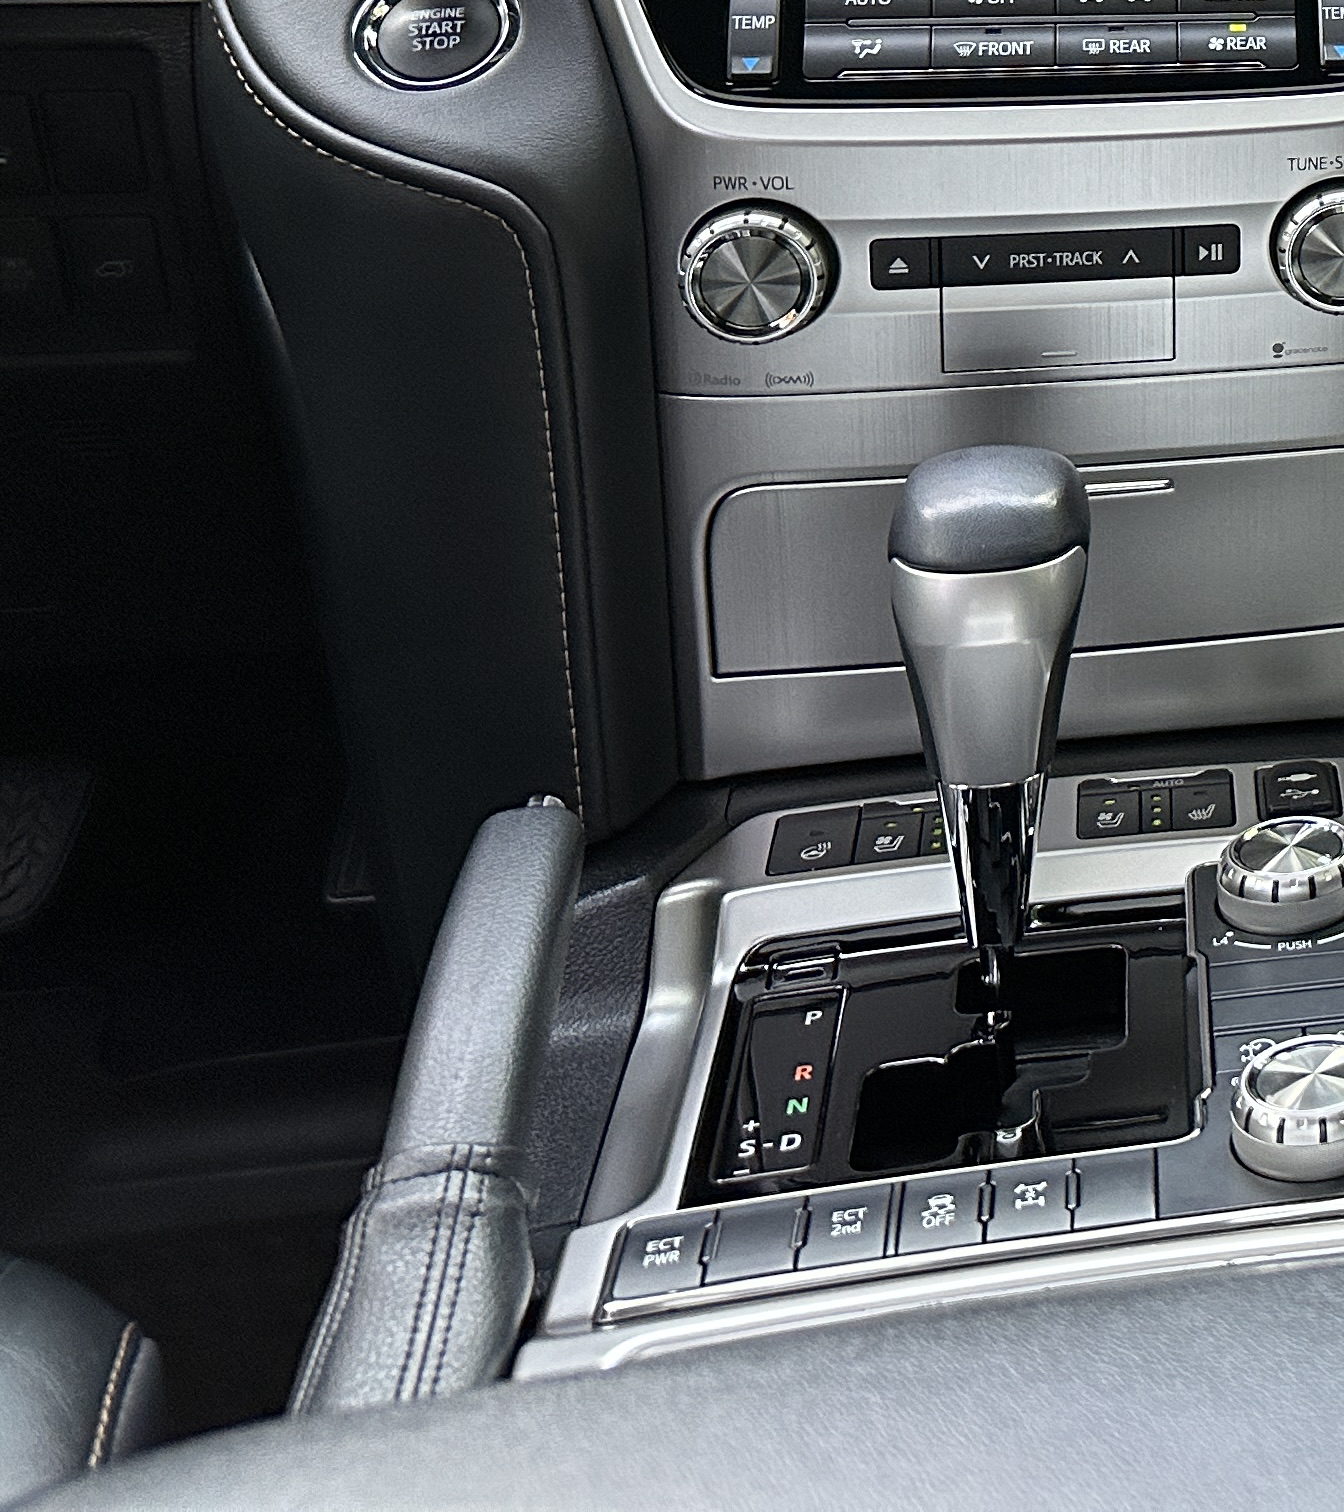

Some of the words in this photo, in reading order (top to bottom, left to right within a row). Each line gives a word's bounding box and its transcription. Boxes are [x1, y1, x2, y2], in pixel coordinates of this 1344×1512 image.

[411, 7, 465, 20] ENGINE
[408, 20, 466, 37] START
[732, 15, 776, 30] TEMP
[412, 35, 460, 52] STOP
[978, 40, 1034, 56] FRONT
[1109, 39, 1150, 54] REAR
[1226, 37, 1267, 51] REAR
[1152, 778, 1185, 788] AUTO
[1212, 936, 1229, 947] L4
[1277, 939, 1313, 952] PUSH
[804, 1010, 823, 1026] P
[794, 1064, 813, 1081] R
[786, 1097, 809, 1115] N
[832, 1206, 868, 1223] ECT
[922, 1212, 955, 1229] OFF
[831, 1221, 862, 1237] 2nd
[645, 1235, 684, 1253] ECT
[643, 1249, 681, 1268] PWR
